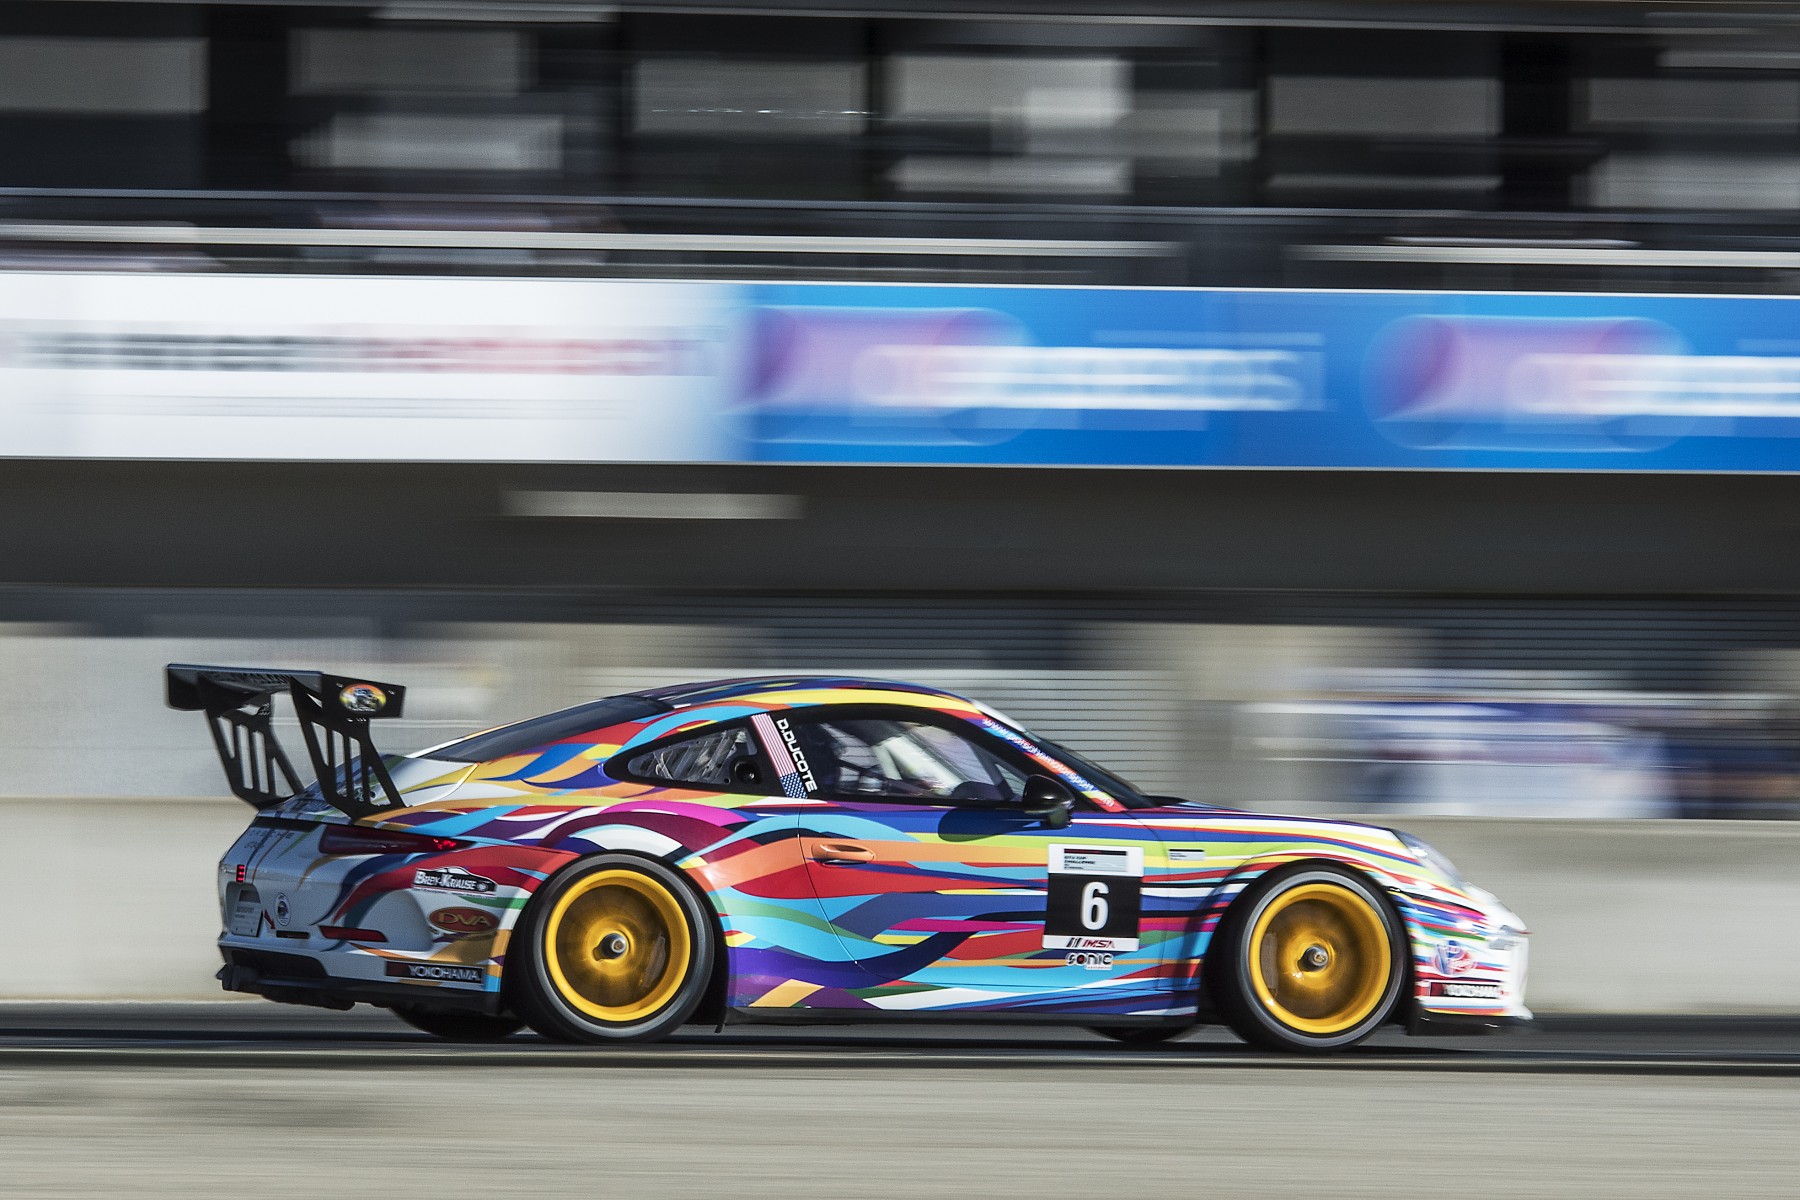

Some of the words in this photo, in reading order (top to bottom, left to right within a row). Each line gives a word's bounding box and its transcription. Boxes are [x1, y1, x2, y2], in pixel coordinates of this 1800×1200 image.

[776, 718, 818, 793] D.DUCOTE
[1081, 881, 1109, 930] 6
[437, 912, 492, 927] DVA
[1082, 939, 1115, 949] IMSA
[408, 965, 479, 981] YOKOHAMA
